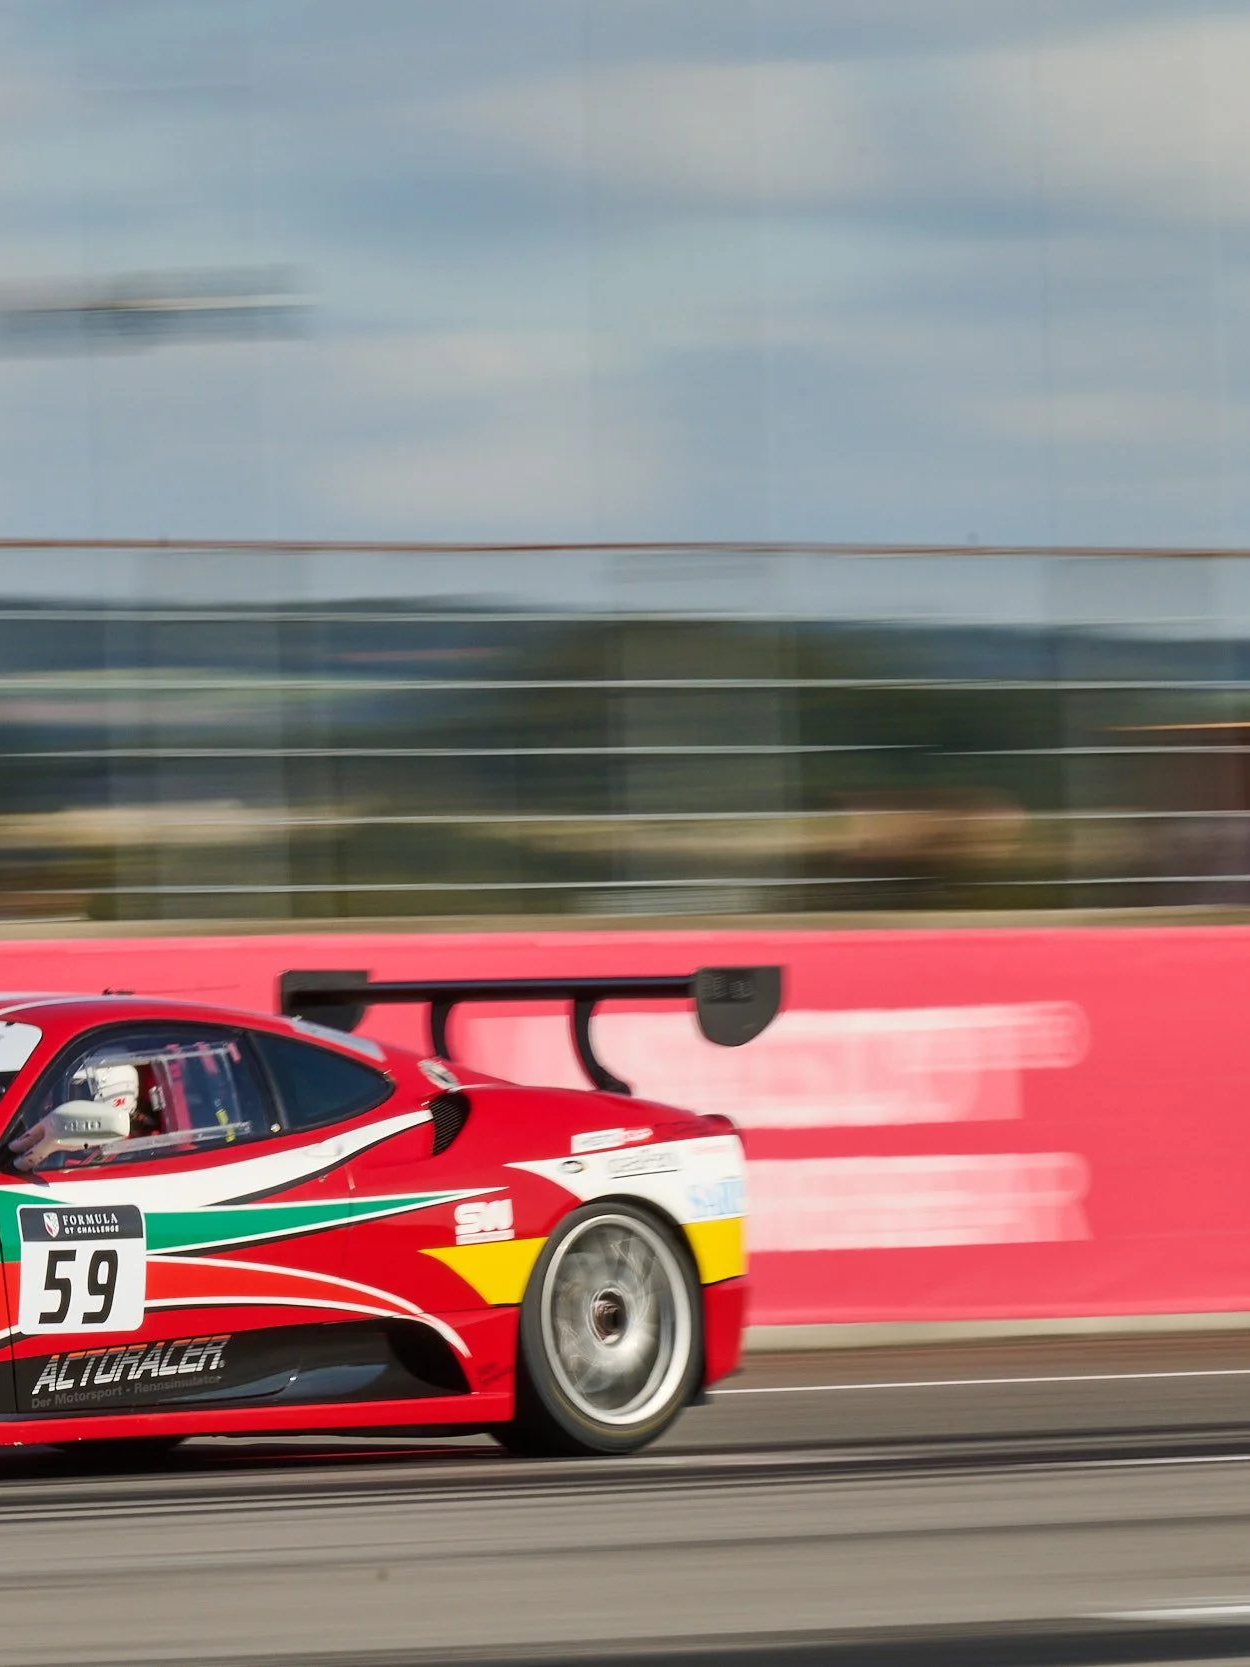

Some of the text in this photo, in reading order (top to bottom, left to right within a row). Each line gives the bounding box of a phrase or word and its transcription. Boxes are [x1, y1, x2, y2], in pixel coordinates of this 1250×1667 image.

[62, 1212, 118, 1226] FORMULA
[64, 1224, 120, 1235] GT CHALLENGE
[38, 1249, 119, 1324] 59
[31, 1396, 51, 1409] Der
[54, 1385, 123, 1406] Motorsport
[134, 1375, 222, 1393] Rennsimulator
